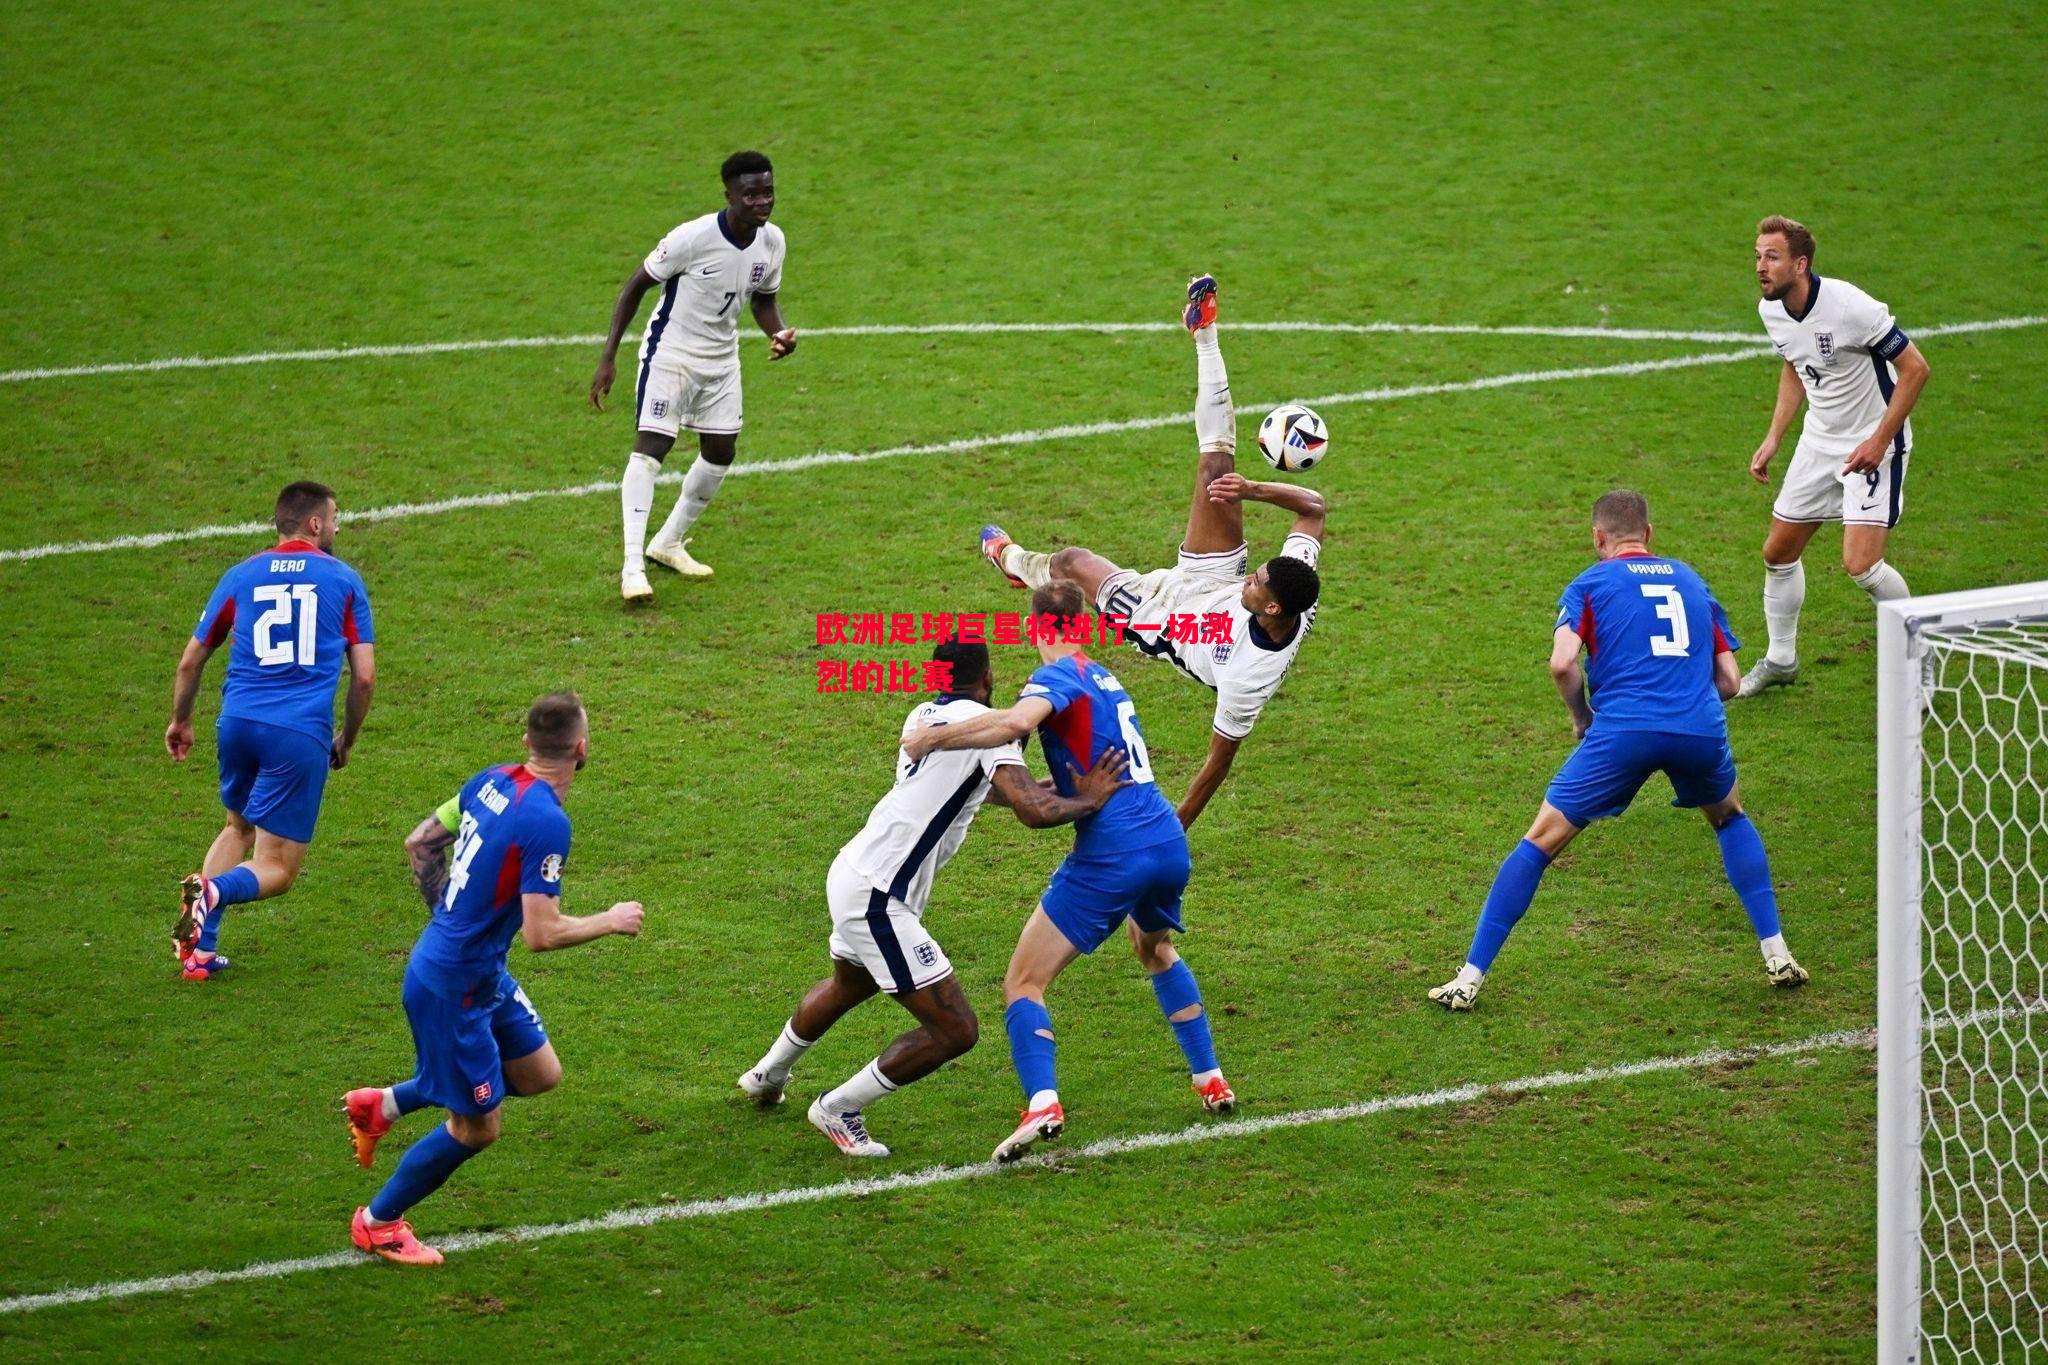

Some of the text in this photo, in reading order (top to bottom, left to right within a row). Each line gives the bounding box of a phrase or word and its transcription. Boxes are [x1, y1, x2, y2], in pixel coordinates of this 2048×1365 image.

[717, 292, 736, 316] 7
[1805, 364, 1821, 387] 9
[1866, 470, 1880, 498] 9
[253, 584, 318, 666] 21
[1640, 584, 1690, 657] 3
[1116, 700, 1155, 784] 6
